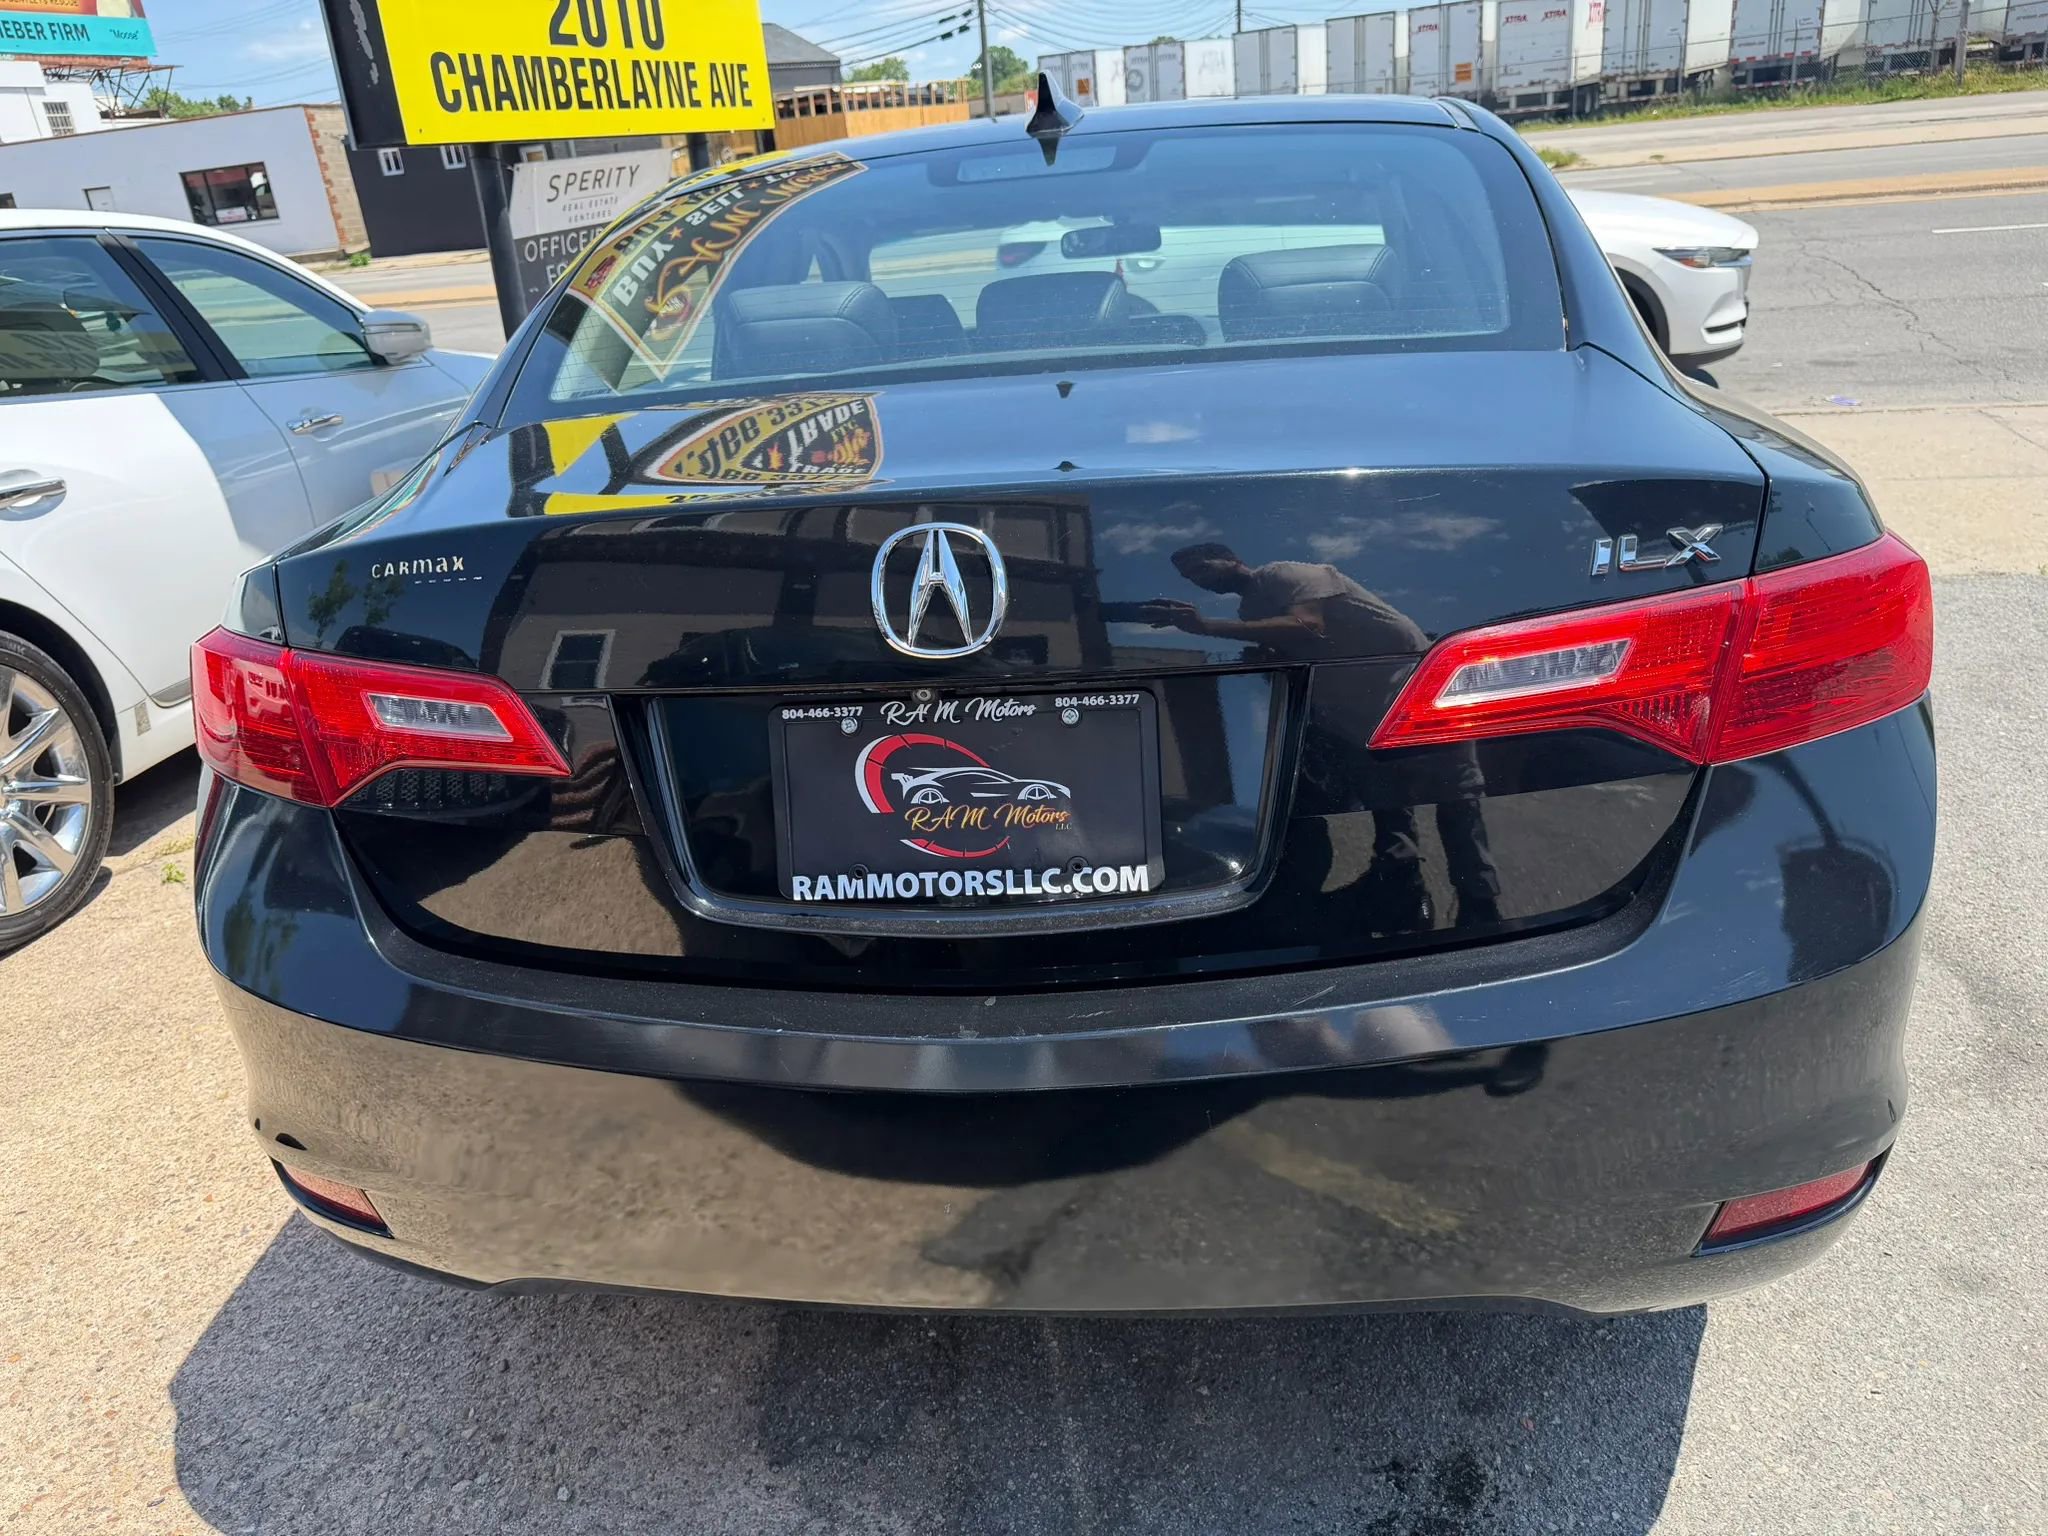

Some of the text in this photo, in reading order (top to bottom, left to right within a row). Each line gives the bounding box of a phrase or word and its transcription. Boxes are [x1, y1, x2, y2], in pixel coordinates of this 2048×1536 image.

[48, 22, 91, 42] FIRM
[549, 0, 665, 50] 2010
[430, 52, 753, 113] CHAMBERLAYNE AVE
[546, 164, 640, 203] SPERITY
[1590, 523, 1724, 577] ILX
[781, 706, 864, 720] 804-466-3377
[964, 697, 1037, 722] Motors
[1055, 694, 1140, 707] 804-466-3377
[904, 803, 1072, 833] RAM Motors
[791, 864, 1150, 900] RAMMOTORSLLC.COM
